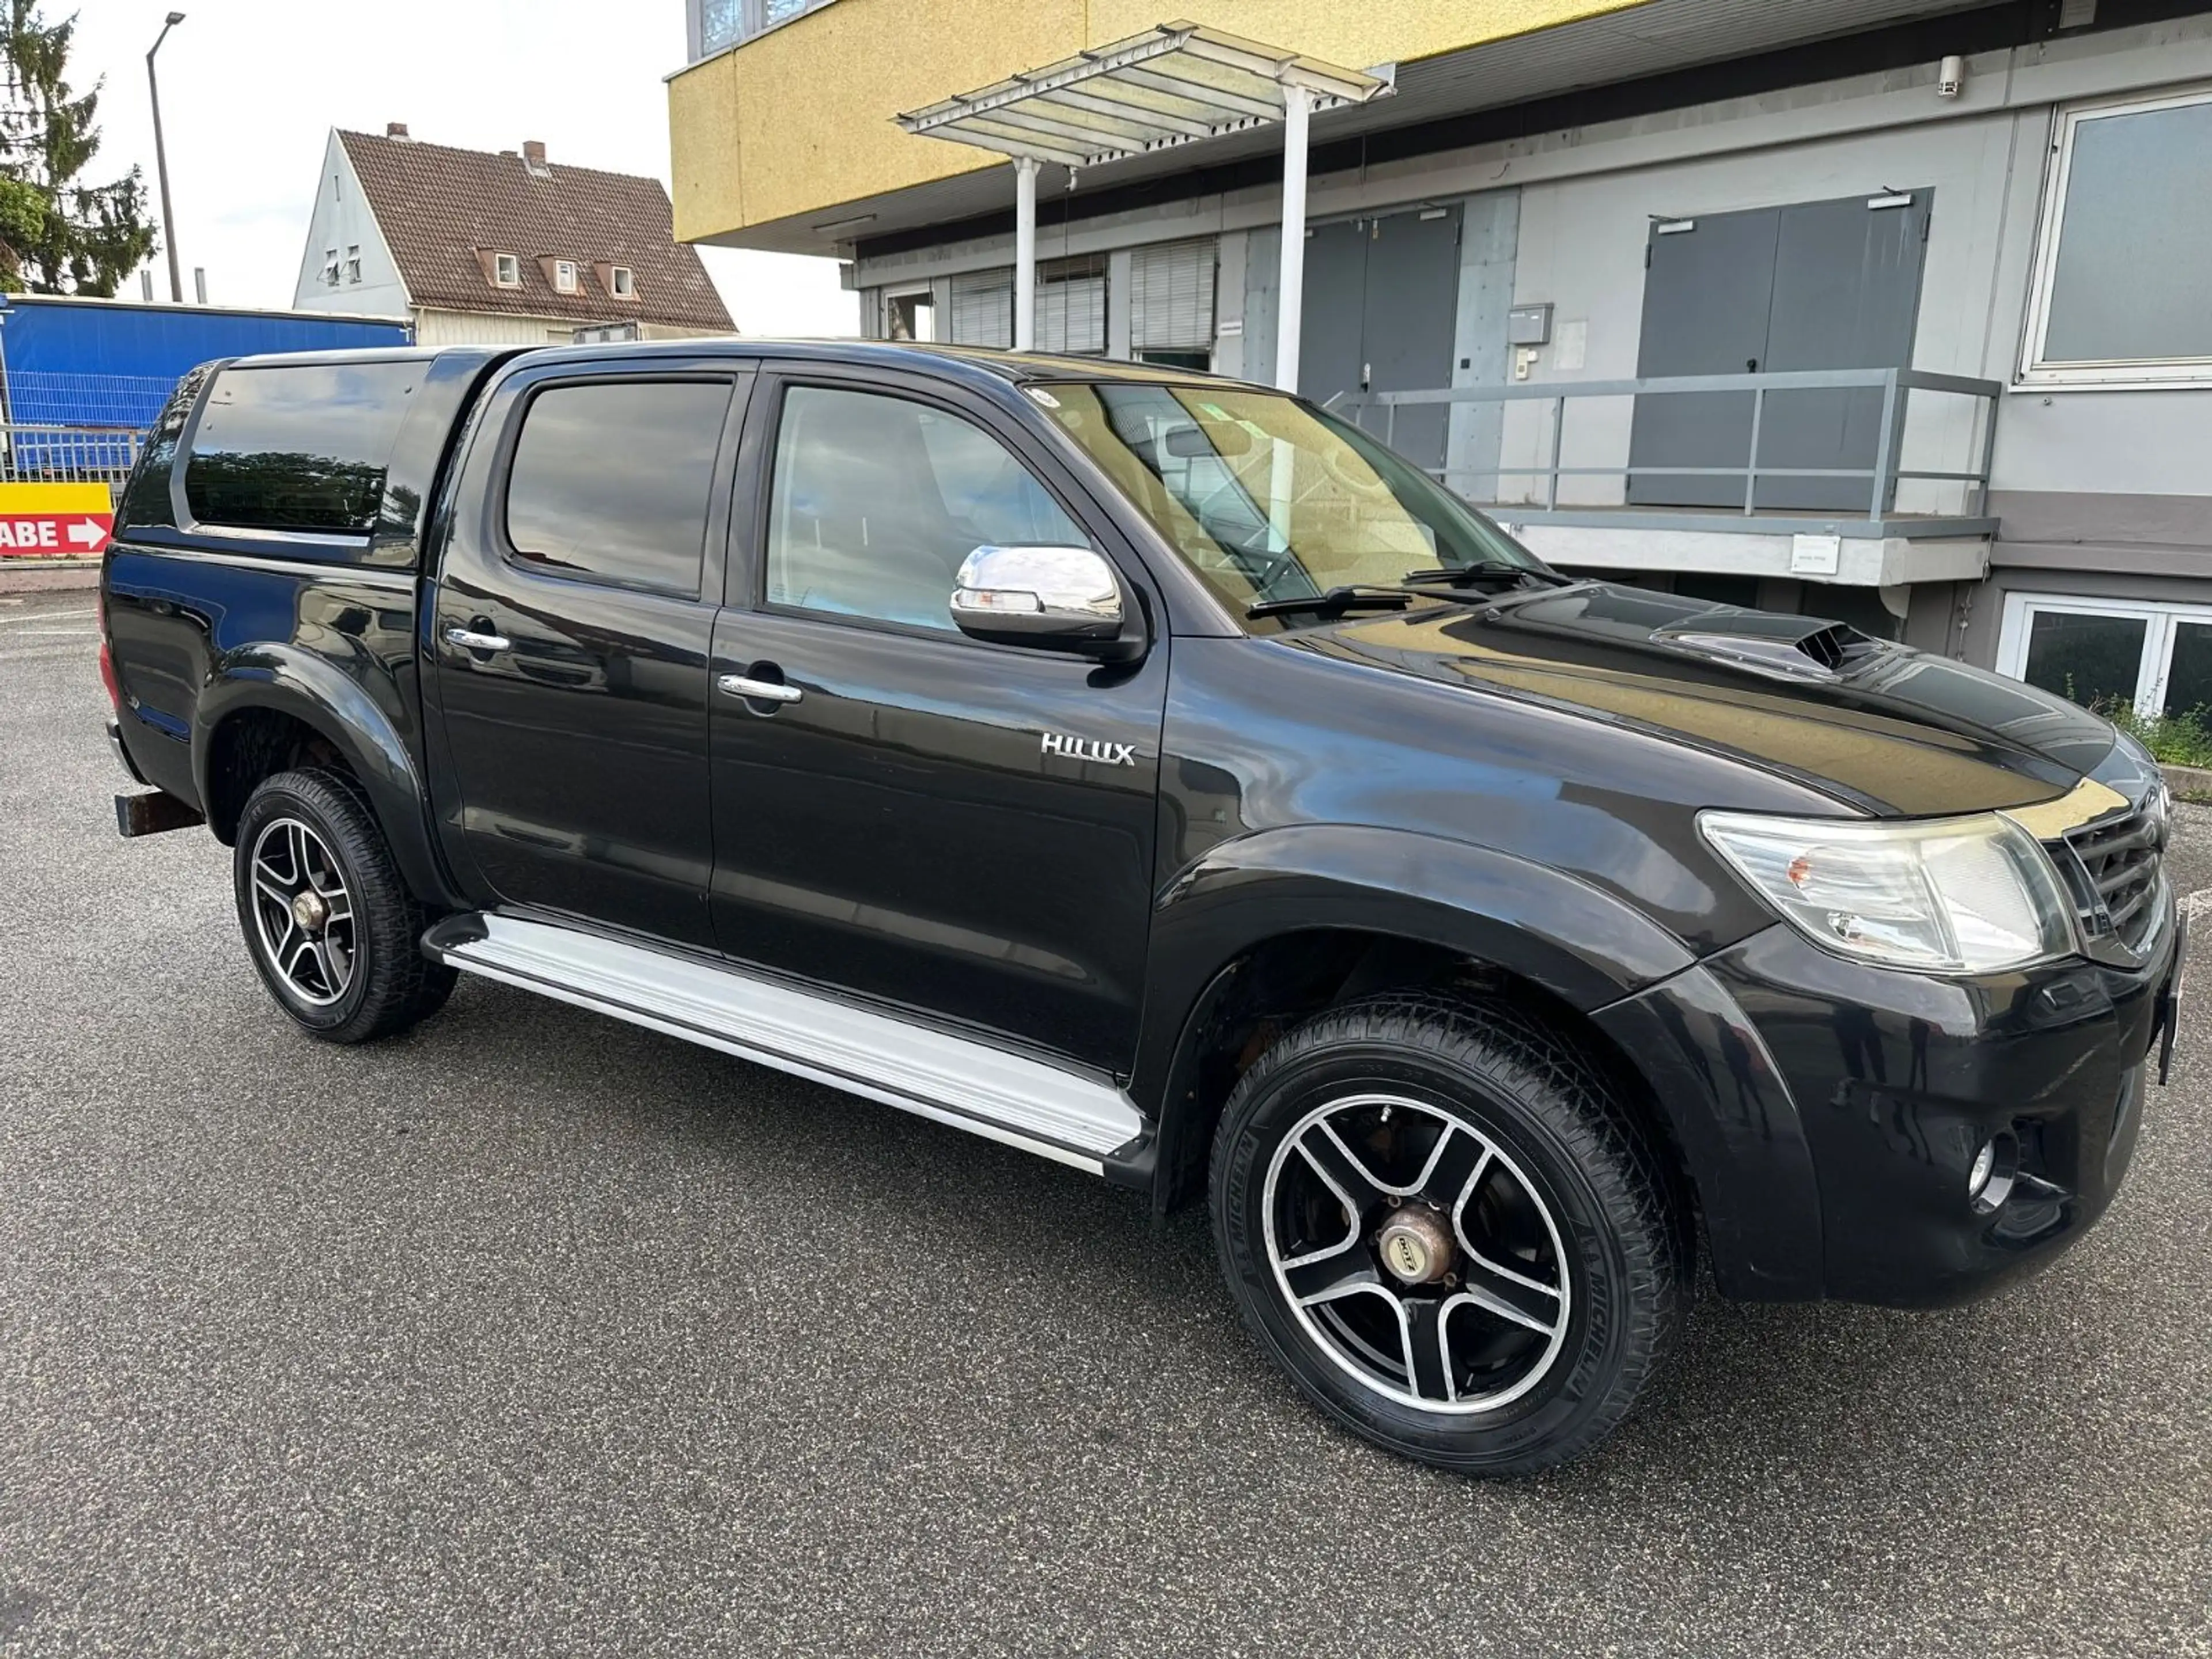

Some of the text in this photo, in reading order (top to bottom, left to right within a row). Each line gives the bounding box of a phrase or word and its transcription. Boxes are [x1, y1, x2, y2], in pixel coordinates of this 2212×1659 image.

[1041, 732, 1137, 767] HILUX
[1230, 1130, 1257, 1241] MICHELIN
[1398, 1237, 1416, 1271] DOTZ
[1569, 1271, 1607, 1396] MICHELIN
